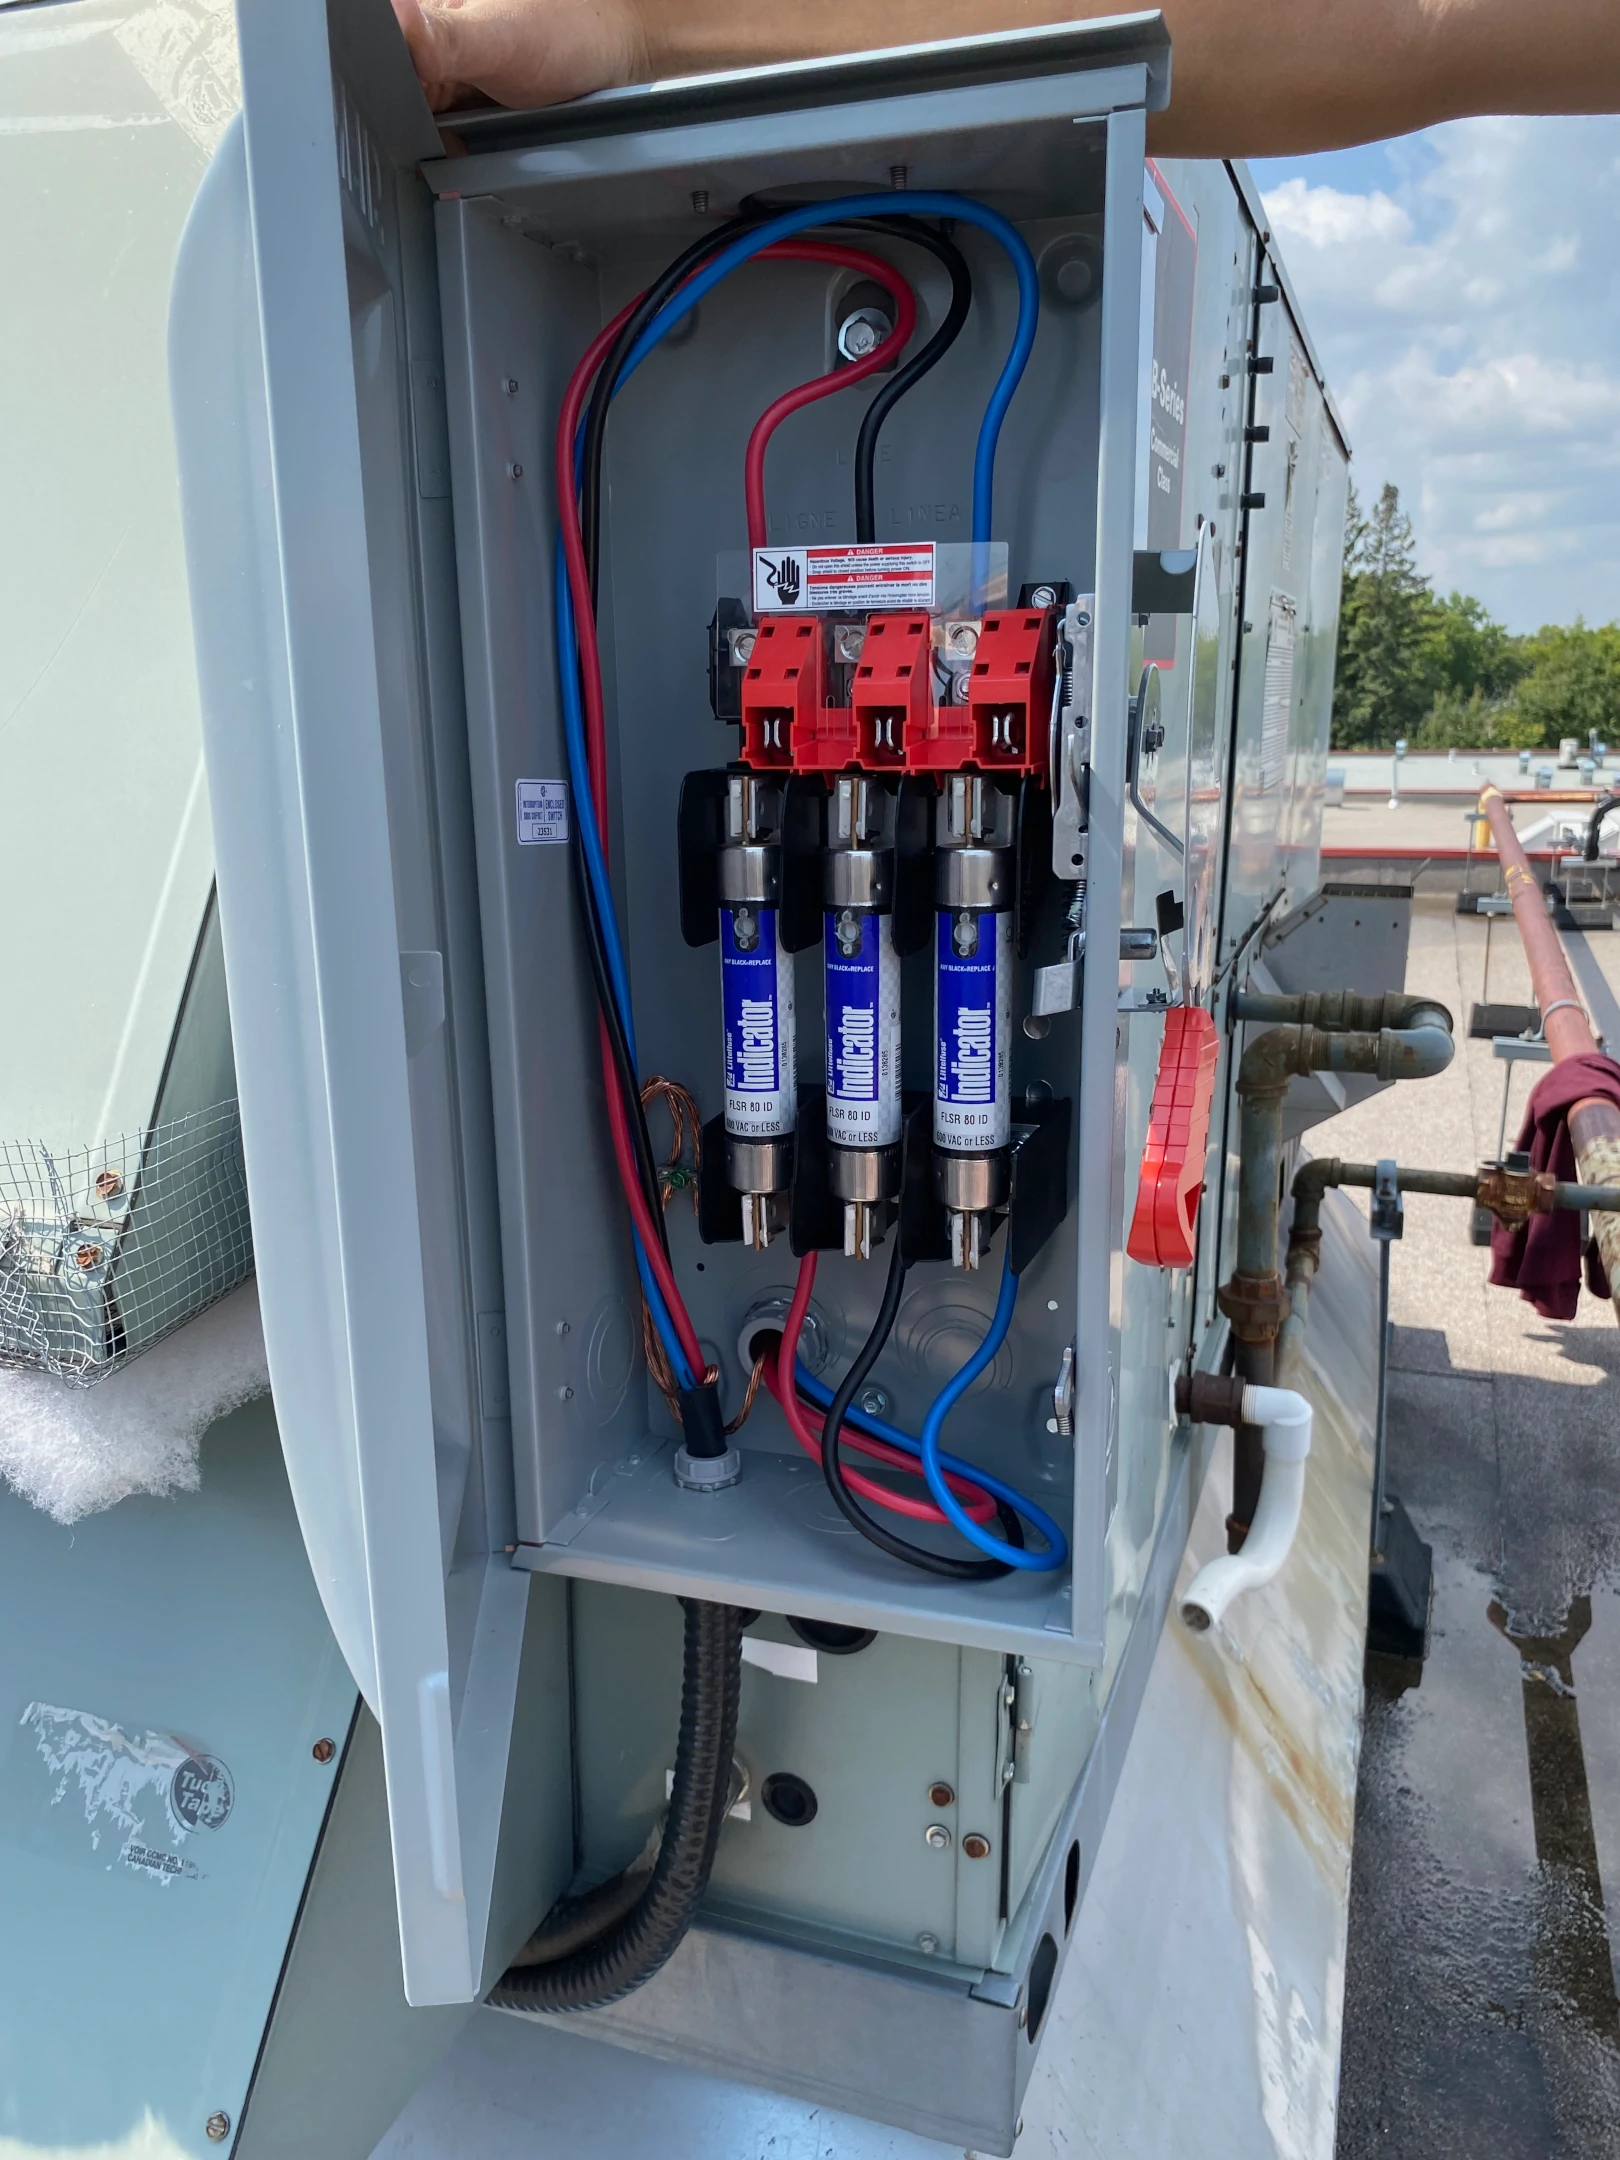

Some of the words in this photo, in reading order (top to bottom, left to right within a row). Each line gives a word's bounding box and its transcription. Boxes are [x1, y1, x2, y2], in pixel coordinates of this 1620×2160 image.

[1151, 358, 1184, 425] B-Series
[1150, 427, 1180, 469] Commercial
[1157, 465, 1171, 494] Class
[768, 510, 836, 531] LIGNE
[890, 503, 962, 525] LINEA
[729, 1099, 747, 1112] FLSR
[750, 1102, 760, 1112] 80
[763, 1102, 773, 1112] ID
[829, 1105, 845, 1119] FLSR
[848, 1110, 858, 1121] 80
[861, 1111, 871, 1121] ID
[736, 1120, 749, 1132] VAC
[751, 1124, 759, 1132] or
[761, 1121, 780, 1132] LESS
[941, 1111, 961, 1125] FLSR
[964, 1114, 975, 1125] 80
[978, 1114, 988, 1125] ID
[834, 1128, 847, 1141] VAC
[848, 1133, 857, 1142] or
[858, 1131, 879, 1142] LESS
[947, 1134, 962, 1146] VAC
[964, 1138, 974, 1146] or
[975, 1134, 995, 1146] LESS
[127, 1853, 161, 1870] CANADIAN
[147, 1849, 167, 1861] CCMC
